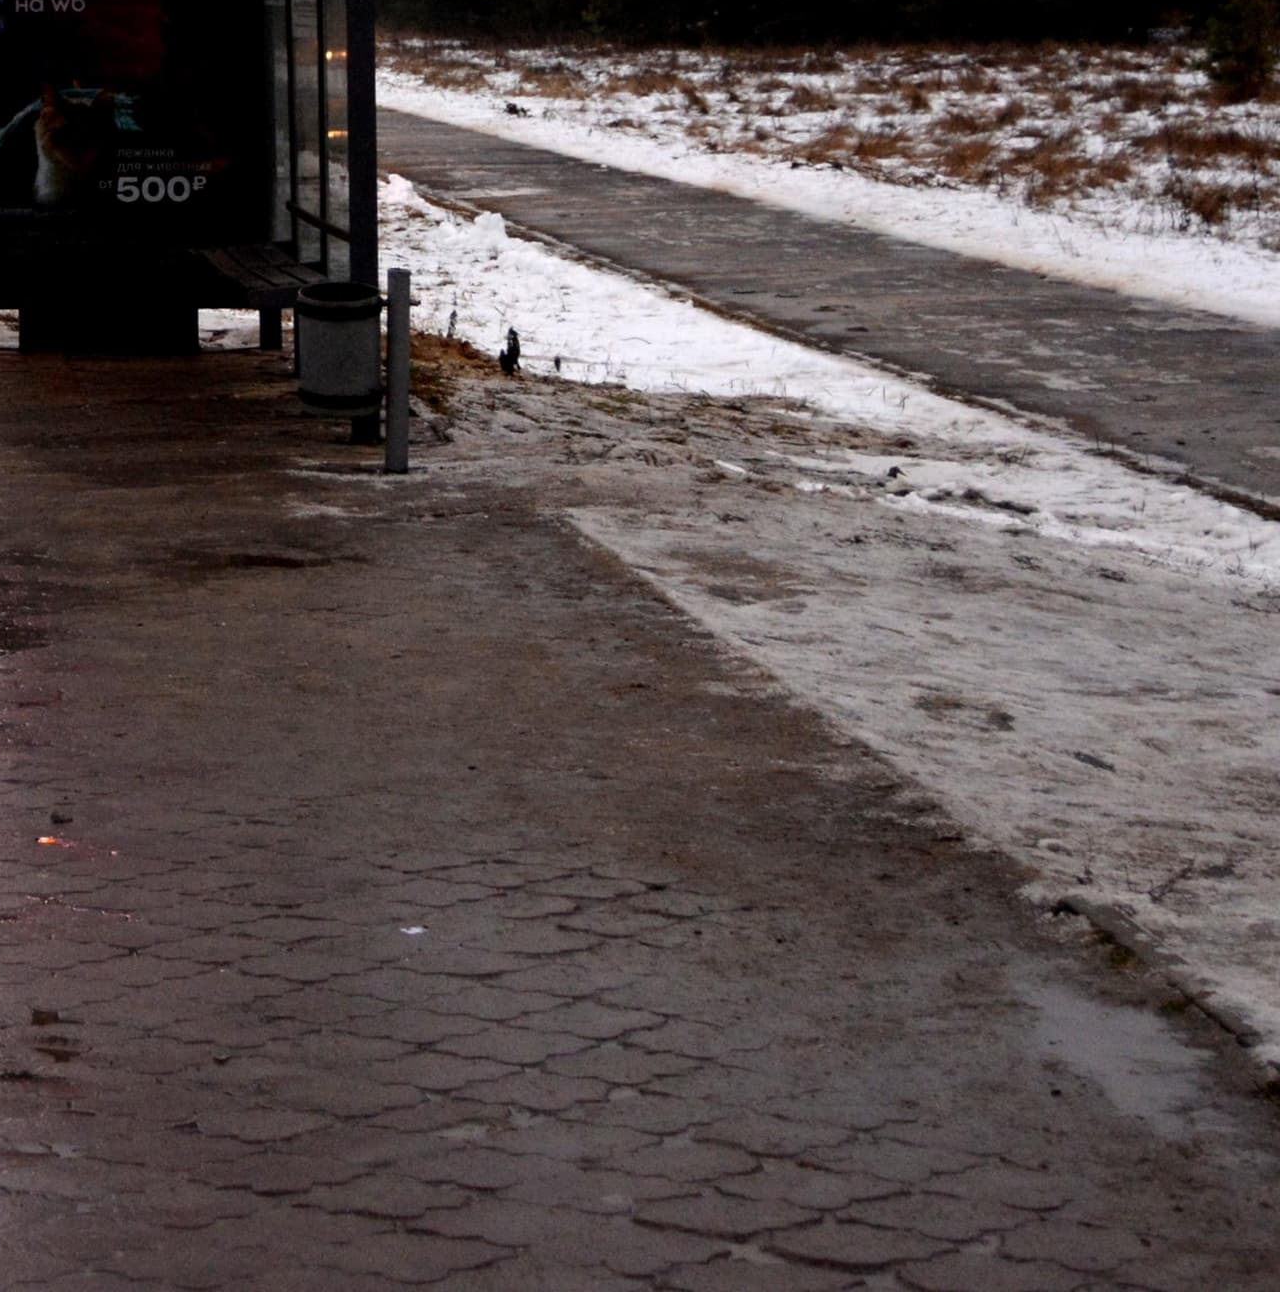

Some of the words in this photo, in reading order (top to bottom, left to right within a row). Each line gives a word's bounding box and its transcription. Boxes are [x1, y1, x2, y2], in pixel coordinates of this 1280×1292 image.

[116, 148, 175, 158] лежанка
[117, 162, 142, 173] для
[98, 180, 113, 189] от
